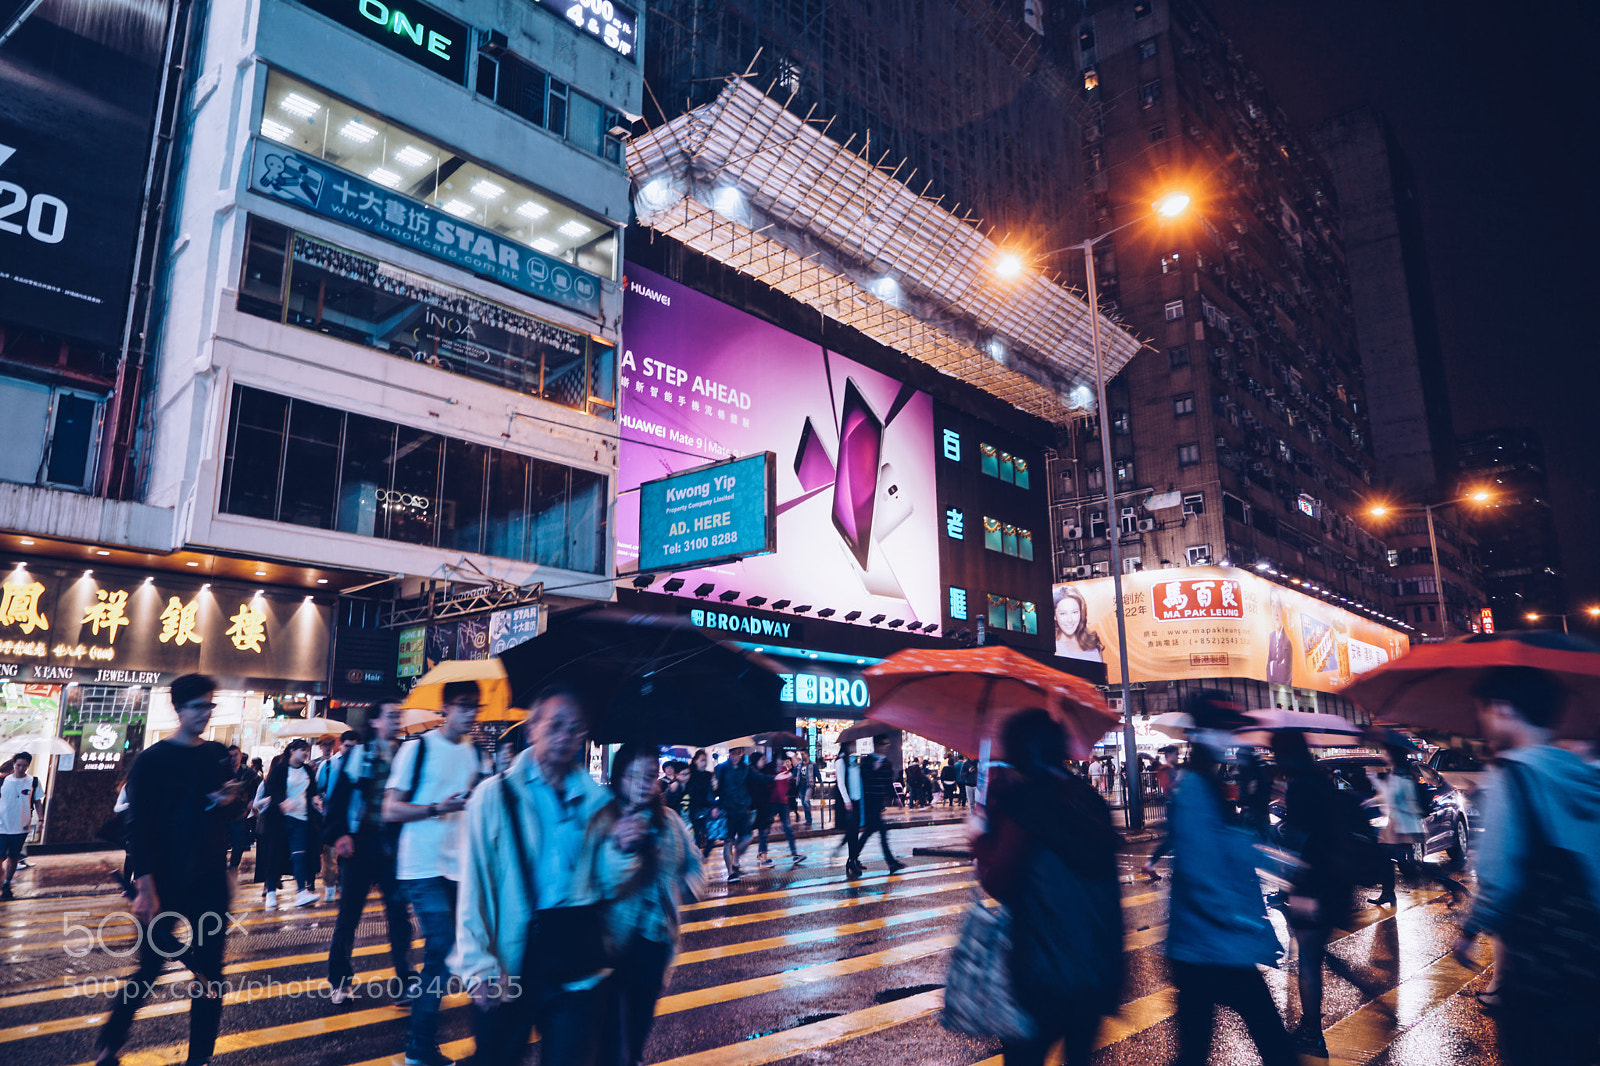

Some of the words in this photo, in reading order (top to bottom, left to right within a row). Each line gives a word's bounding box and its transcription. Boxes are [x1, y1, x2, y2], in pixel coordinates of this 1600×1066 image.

[566, 4, 585, 27] 4
[359, 0, 451, 61] ONE
[333, 180, 430, 236] 十大書坊
[435, 219, 520, 271] STAR
[330, 203, 519, 282] www.bookcafe.com.hk
[630, 281, 671, 307] HUAWEI
[621, 350, 637, 371] A
[642, 357, 689, 387] STEP
[691, 375, 752, 410] AHEAD
[619, 414, 666, 438] HUAWEI
[669, 429, 694, 447] Mate
[665, 484, 710, 503] Kwong
[713, 474, 736, 492] Yip
[665, 502, 688, 515] Property
[688, 499, 713, 511] Company
[713, 492, 735, 504] Limited
[668, 521, 690, 537] AD.
[694, 511, 731, 532] HERE
[662, 543, 681, 556] Tel:
[684, 537, 709, 552] 3100
[711, 531, 738, 547] 8288
[1162, 580, 1239, 611] 馬百良
[0, 582, 267, 654] 鳳祥銀樓
[513, 607, 537, 621] STAR
[706, 611, 791, 638] BROADWAY
[1113, 605, 1148, 618] 22年
[1163, 611, 1181, 619] MA
[1184, 609, 1207, 617] PAK
[1210, 608, 1240, 617] LEUNG
[33, 665, 74, 680] XIANG
[94, 668, 161, 684] JEWELLERY
[819, 676, 871, 707] BRO
